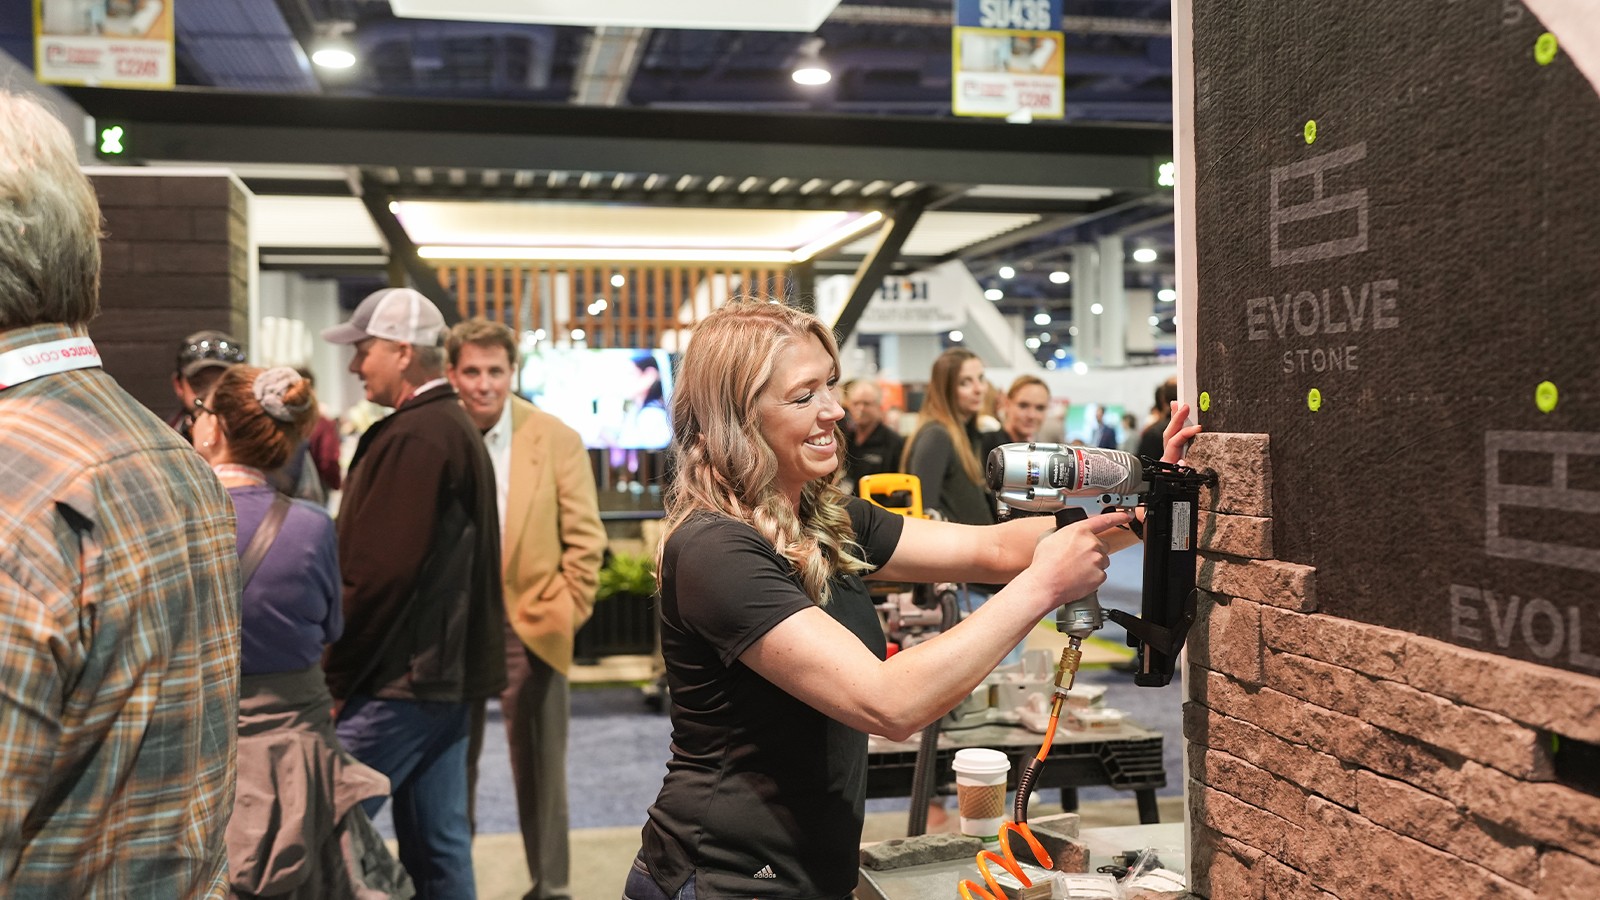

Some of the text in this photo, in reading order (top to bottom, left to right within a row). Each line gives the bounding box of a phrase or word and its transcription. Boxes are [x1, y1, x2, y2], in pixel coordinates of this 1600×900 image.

[1247, 279, 1399, 341] EVOLVE
[1283, 346, 1359, 374] STONE
[1451, 585, 1600, 670] EVOL
